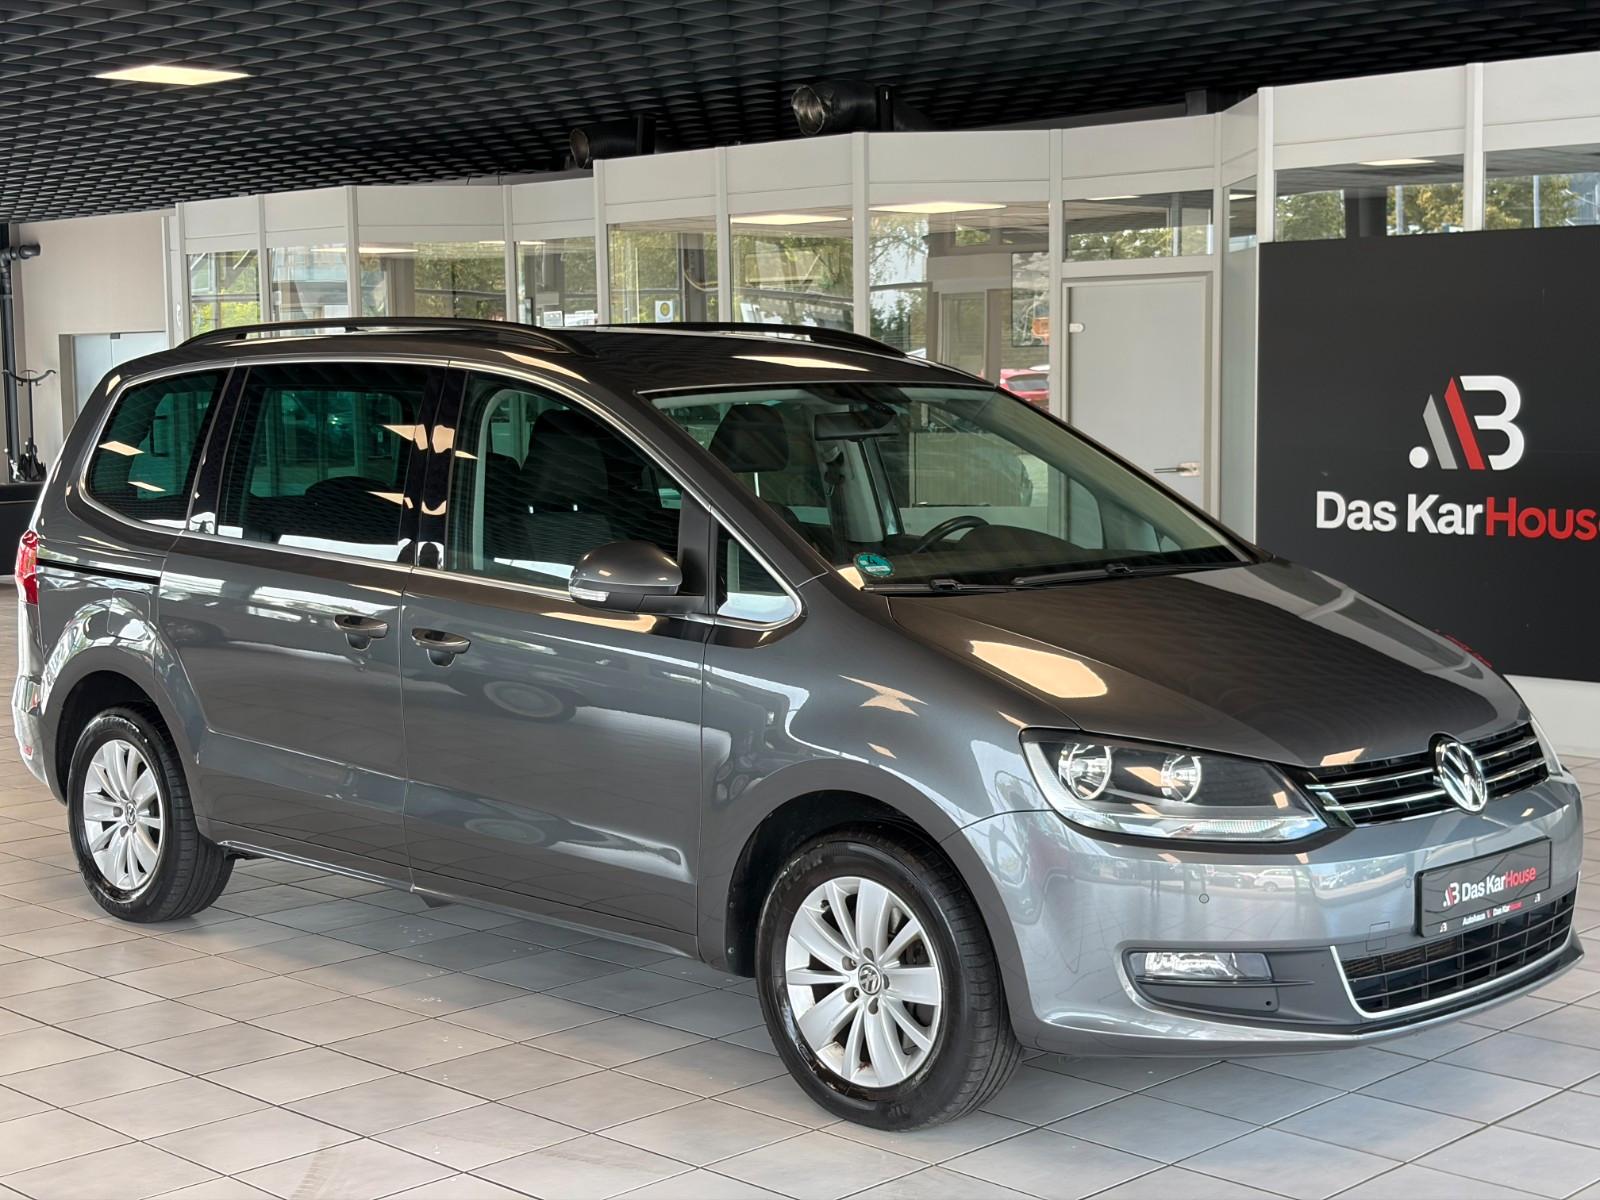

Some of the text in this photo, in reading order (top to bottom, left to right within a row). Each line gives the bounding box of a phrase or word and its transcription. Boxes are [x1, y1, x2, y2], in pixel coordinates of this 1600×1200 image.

[1316, 490, 1600, 541] Das KarHous
[1461, 867, 1537, 902] Das KarHouse
